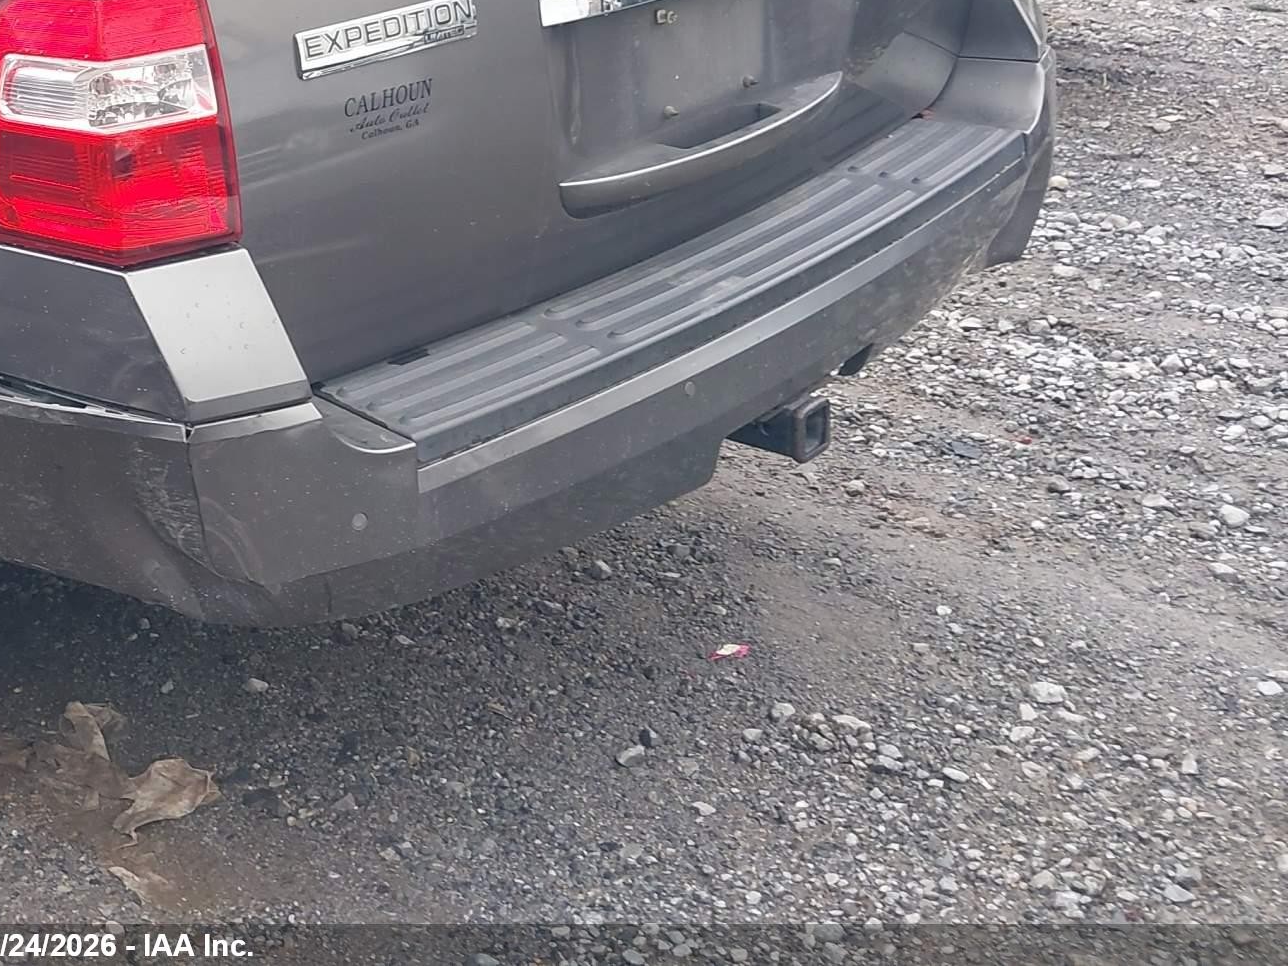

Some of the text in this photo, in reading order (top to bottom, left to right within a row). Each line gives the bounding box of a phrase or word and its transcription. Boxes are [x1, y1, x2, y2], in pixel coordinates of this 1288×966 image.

[344, 78, 432, 117] CALHOUN
[350, 102, 429, 132] Auto Outlet
